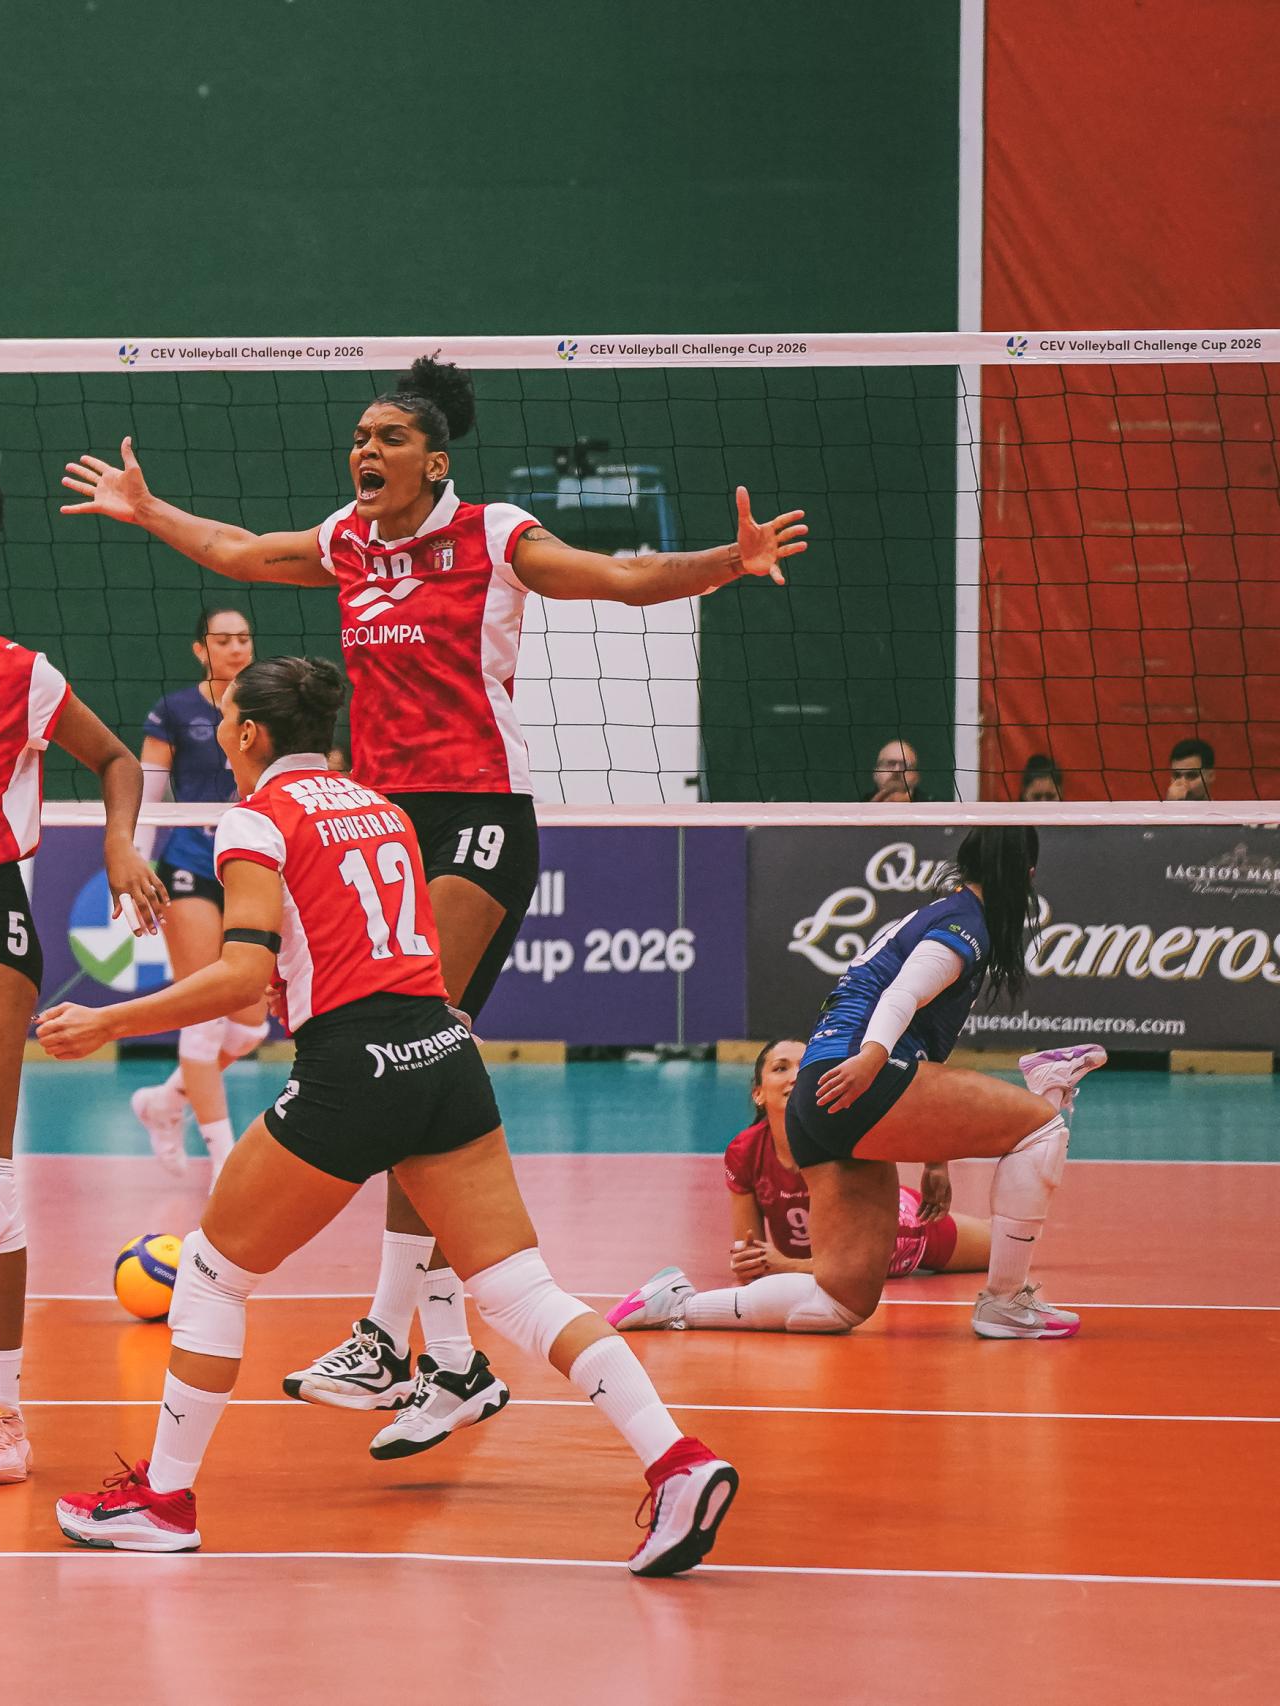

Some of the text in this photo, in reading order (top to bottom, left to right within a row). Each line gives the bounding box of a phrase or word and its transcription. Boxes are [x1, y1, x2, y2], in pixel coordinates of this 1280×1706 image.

[151, 346, 364, 361] CEV Volleyball Challenge Cup 2026
[590, 343, 807, 356] CEV Volleyball Challenge Cup 2026
[1039, 338, 1262, 353] CEV Volleyball Challenge Cup 2026
[341, 625, 426, 648] ECOLIMPA
[315, 810, 406, 847] FIGUEIRAS
[452, 824, 505, 870] 19
[338, 841, 435, 960] 12
[7, 910, 29, 957] 5
[500, 928, 696, 983] up 2026
[365, 1024, 471, 1078] NUTRIBIO
[393, 1043, 462, 1072] THE BIO LIFESTYLE
